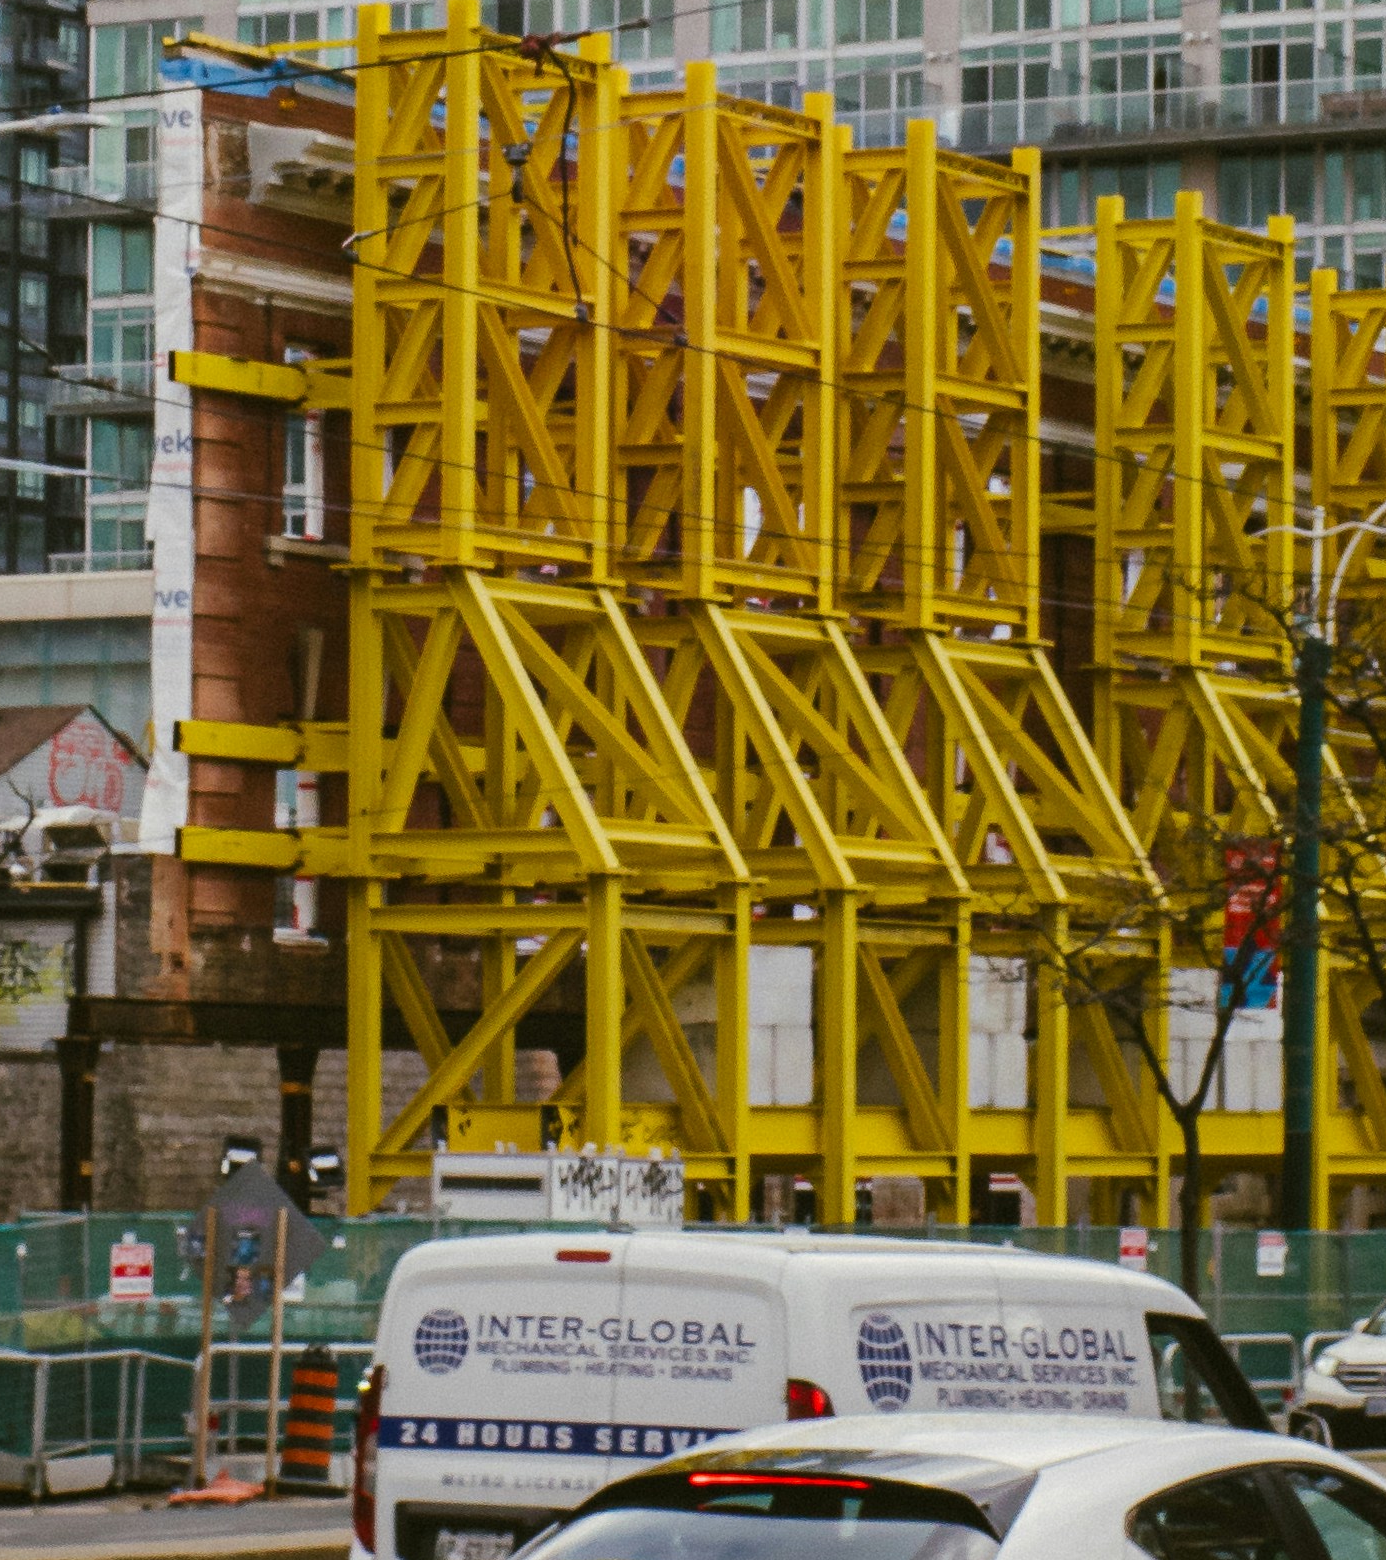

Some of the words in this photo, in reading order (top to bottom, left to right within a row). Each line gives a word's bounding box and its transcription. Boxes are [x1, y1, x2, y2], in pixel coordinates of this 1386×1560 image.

[476, 1313, 756, 1348] INTER-GLOBAL
[914, 1321, 1137, 1362] INTER-GLOBAL
[475, 1340, 599, 1360] MECHANICAL
[607, 1344, 709, 1363] SERVICES
[919, 1361, 1028, 1382] MECHANICAL
[1031, 1364, 1108, 1384] SERVICES
[399, 1421, 439, 1445] 24
[456, 1422, 575, 1451] HOURS
